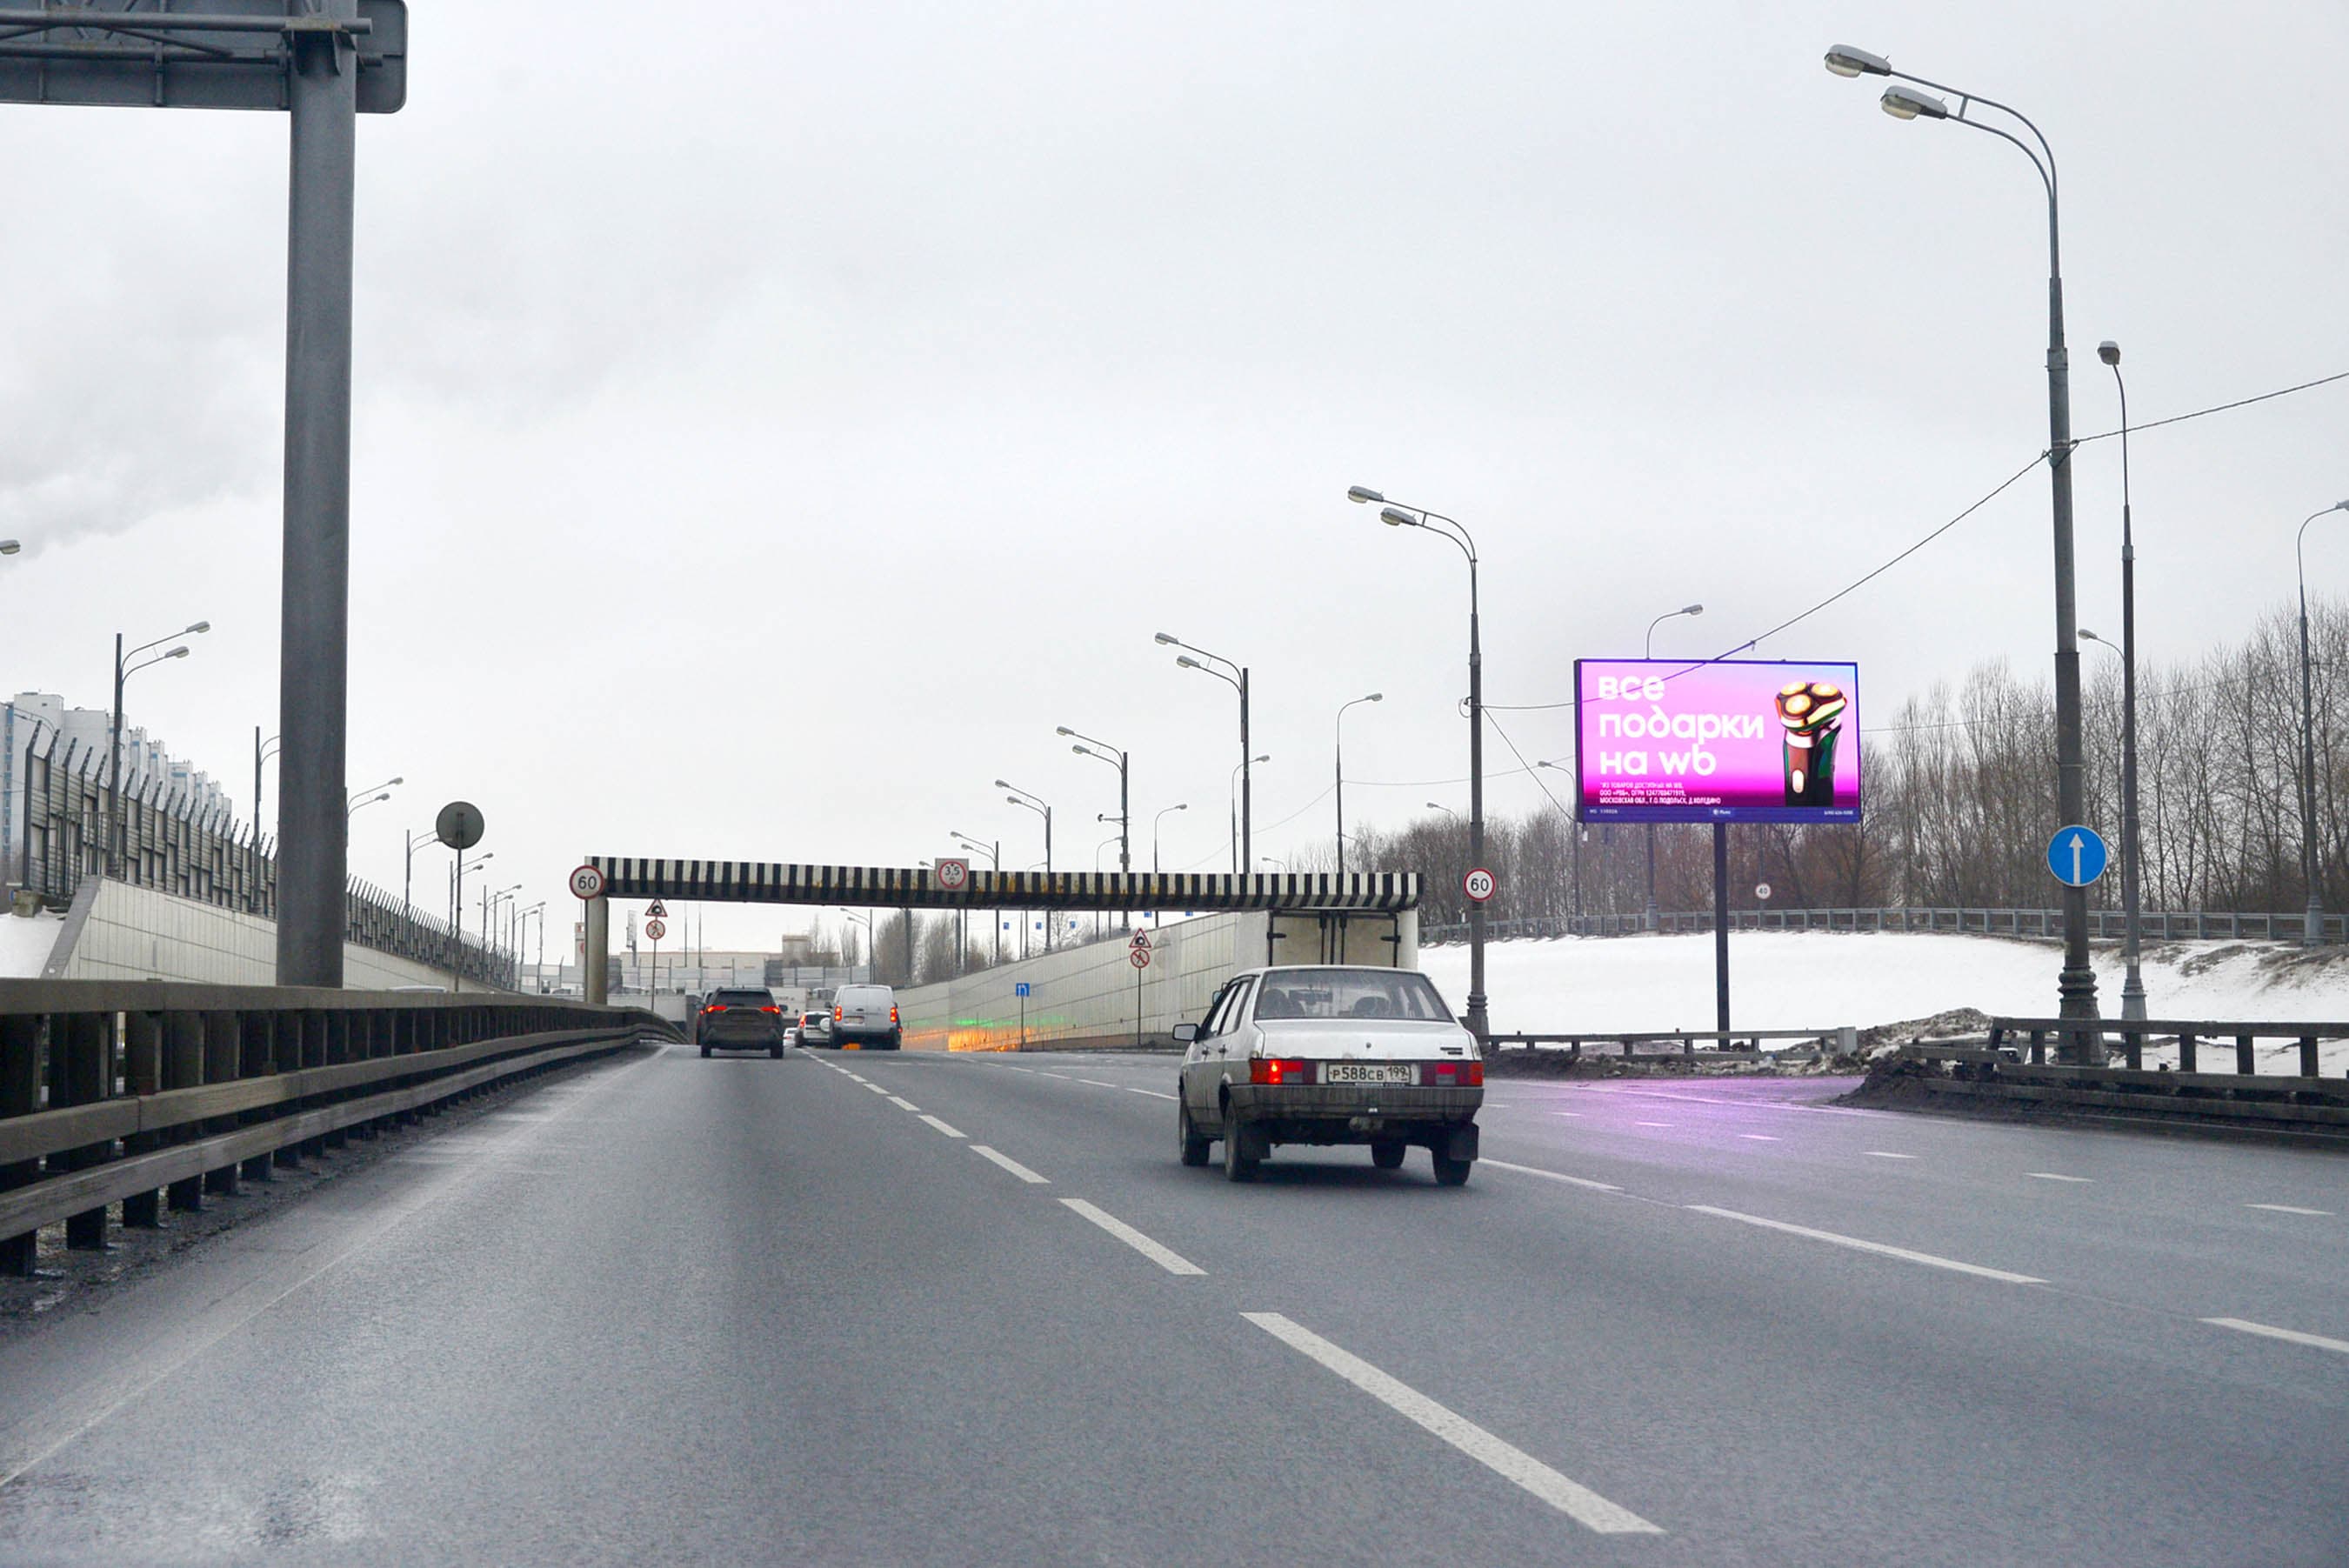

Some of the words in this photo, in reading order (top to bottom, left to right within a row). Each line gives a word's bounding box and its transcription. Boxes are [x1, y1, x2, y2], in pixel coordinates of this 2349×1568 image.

[1598, 676, 1665, 701] все
[1599, 704, 1765, 744] подарки
[1600, 751, 1648, 775] на
[1658, 743, 1717, 776] wb
[577, 876, 597, 890] 60
[1471, 877, 1489, 891] 60
[1387, 1066, 1406, 1078] 199
